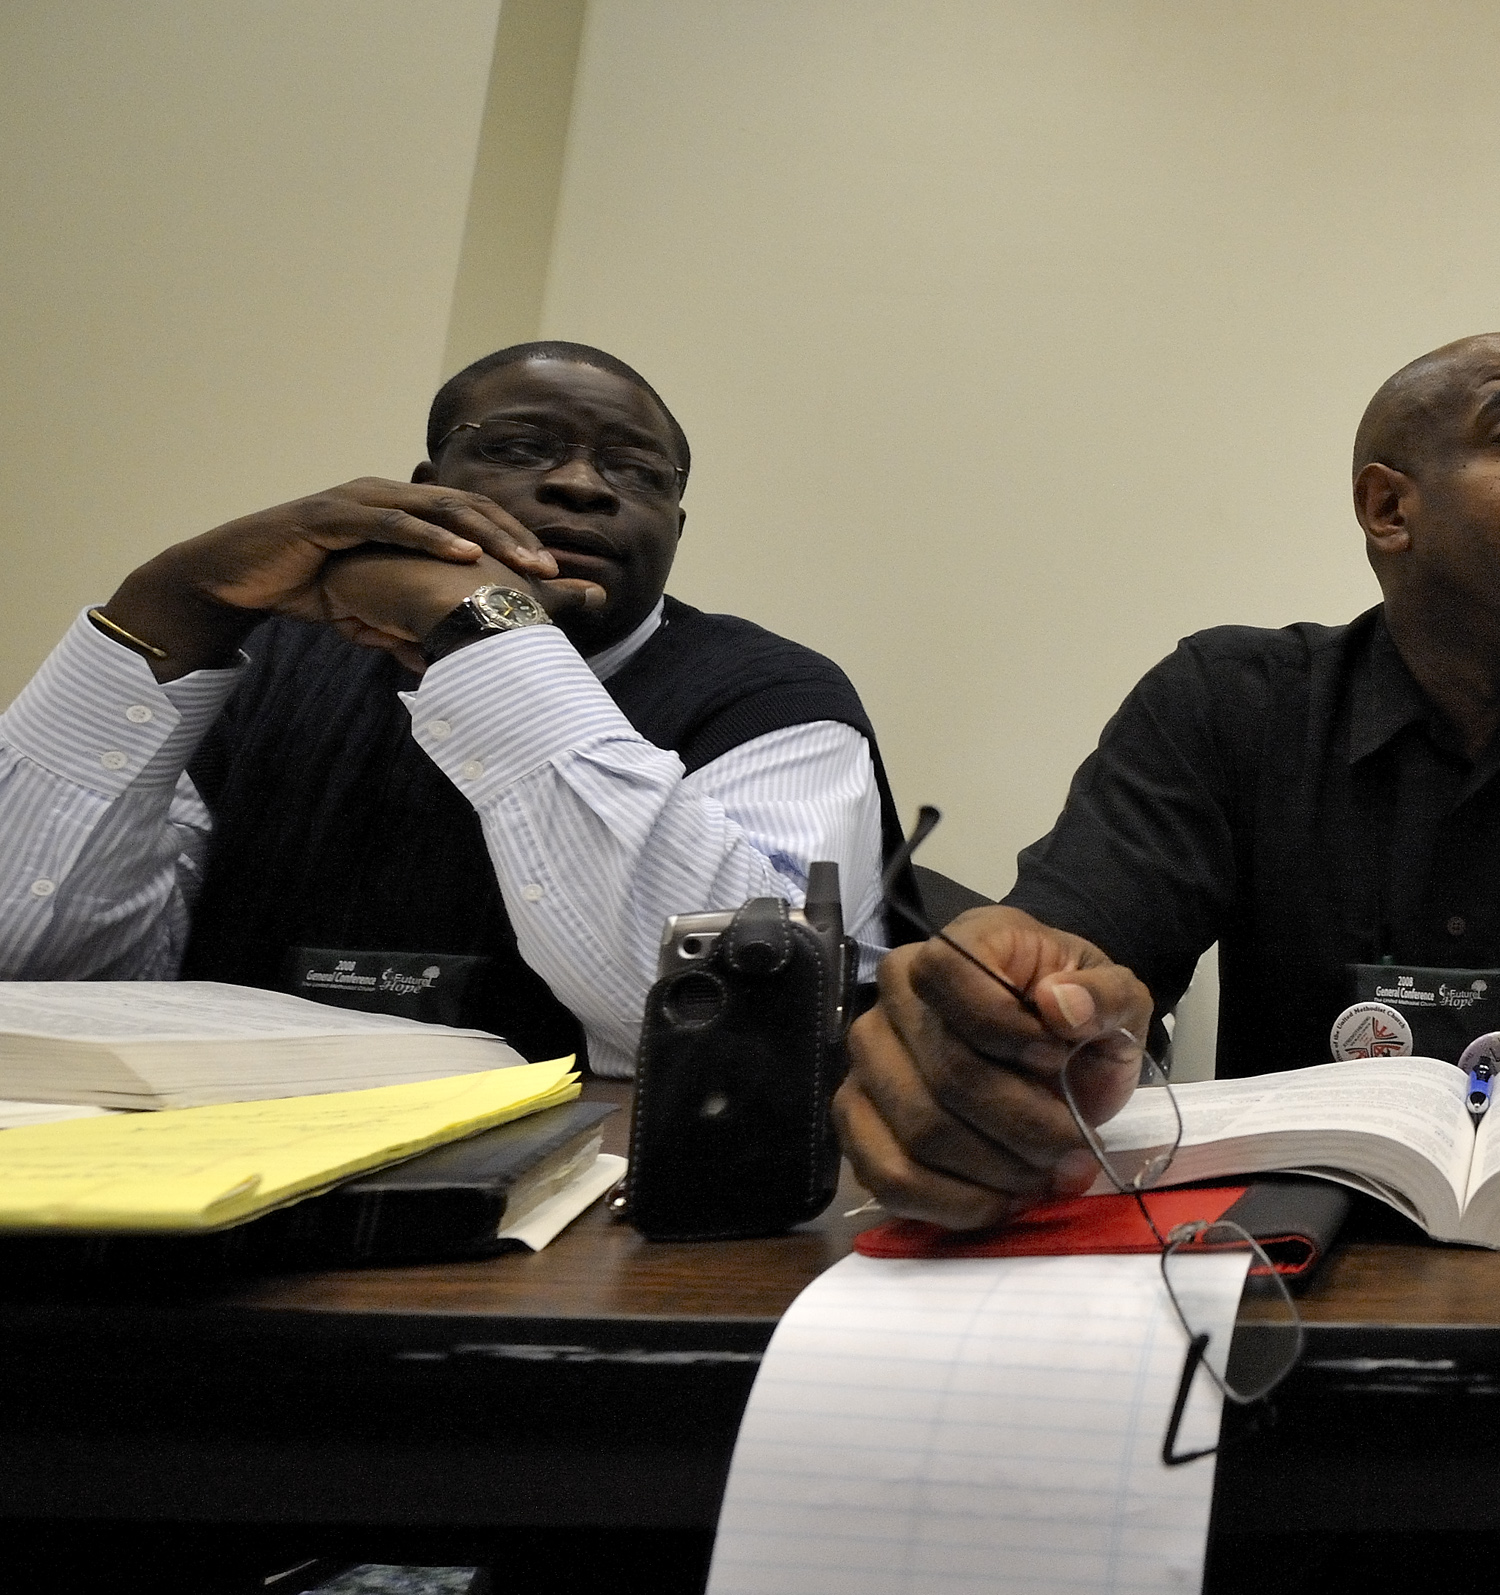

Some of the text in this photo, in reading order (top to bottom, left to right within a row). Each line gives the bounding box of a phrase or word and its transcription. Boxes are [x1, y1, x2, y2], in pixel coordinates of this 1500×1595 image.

[334, 960, 357, 972] 2008
[306, 969, 337, 983] General
[334, 971, 377, 986] Conference
[1397, 975, 1414, 987] 2008
[379, 980, 422, 996] Hope
[1375, 985, 1435, 1002] General Conference
[1440, 996, 1474, 1011] Hope
[1336, 1010, 1354, 1030] United
[1353, 1004, 1386, 1015] Methodist
[1386, 1009, 1406, 1030] Church
